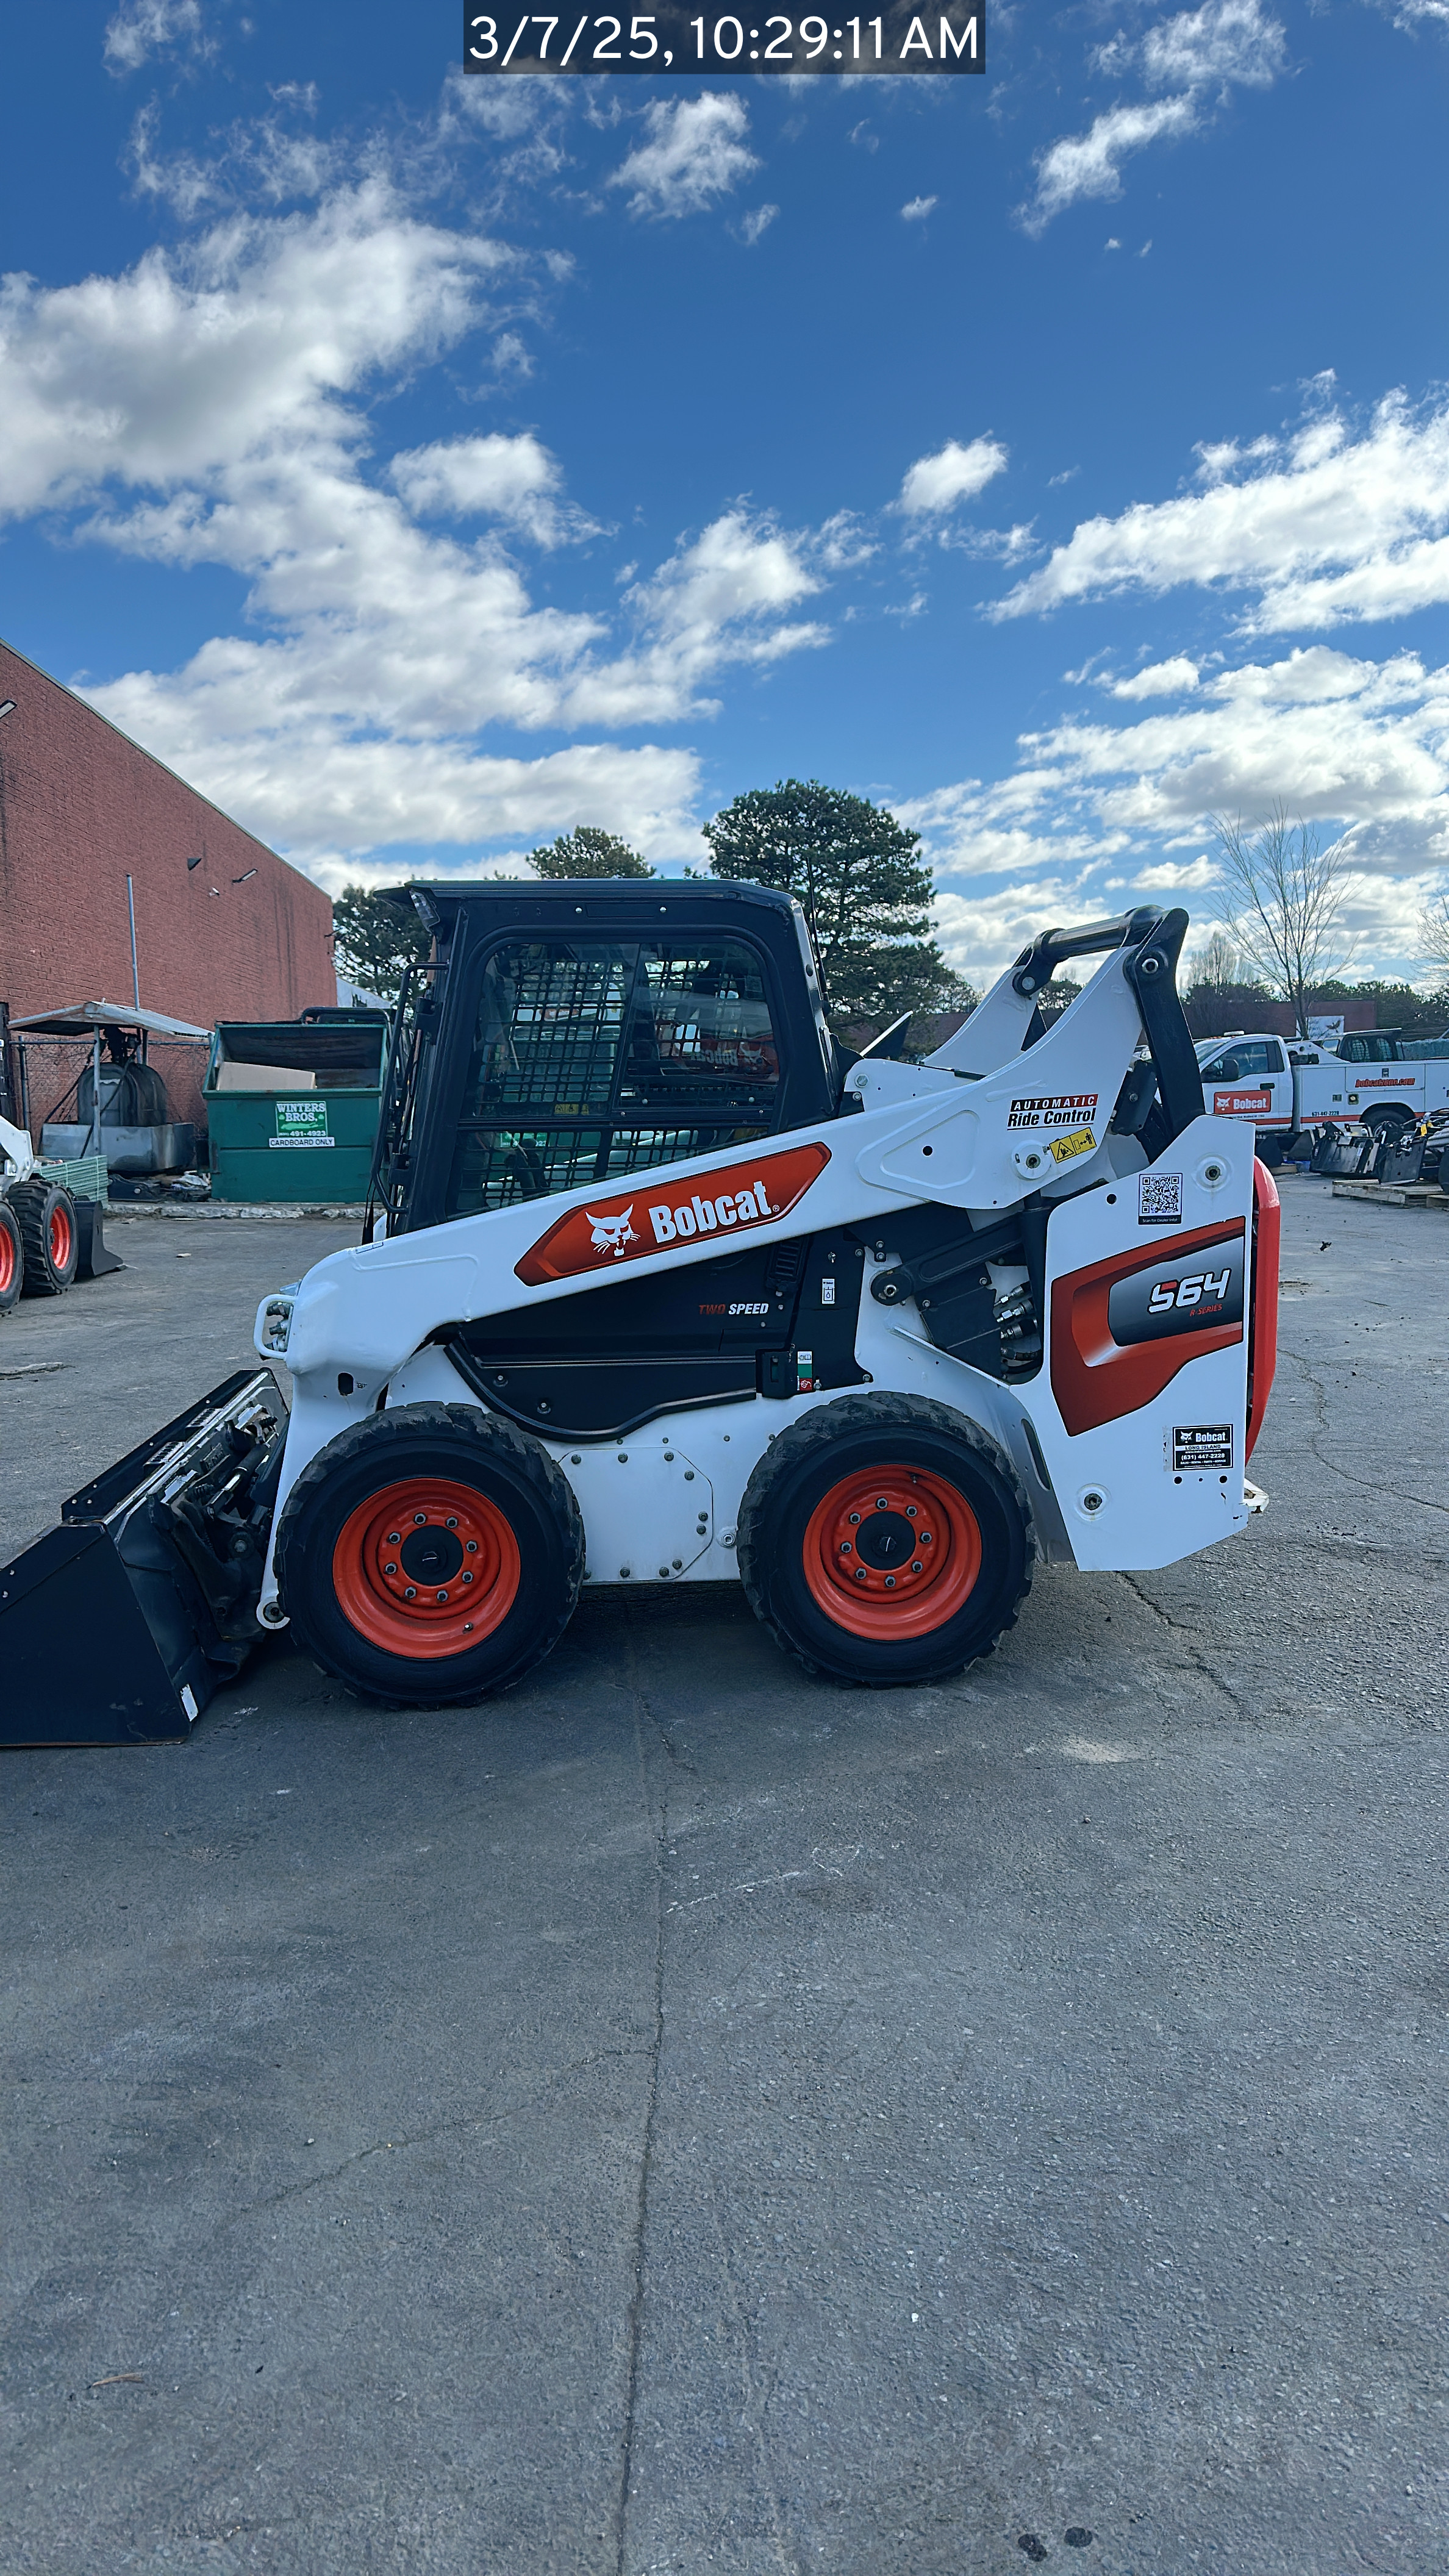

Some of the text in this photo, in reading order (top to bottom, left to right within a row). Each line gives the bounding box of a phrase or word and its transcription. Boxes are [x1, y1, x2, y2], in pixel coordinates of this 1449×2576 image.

[276, 1103, 326, 1112] WINTERS
[1014, 1096, 1095, 1111] AUTOMATIC
[1233, 1098, 1267, 1110] Bobcat
[285, 1112, 318, 1122] BROS.
[1007, 1107, 1097, 1127] Ride Control
[1148, 1268, 1231, 1314] S64
[699, 1303, 769, 1315] TWO SPEED
[1195, 1431, 1226, 1442] Bobcat
